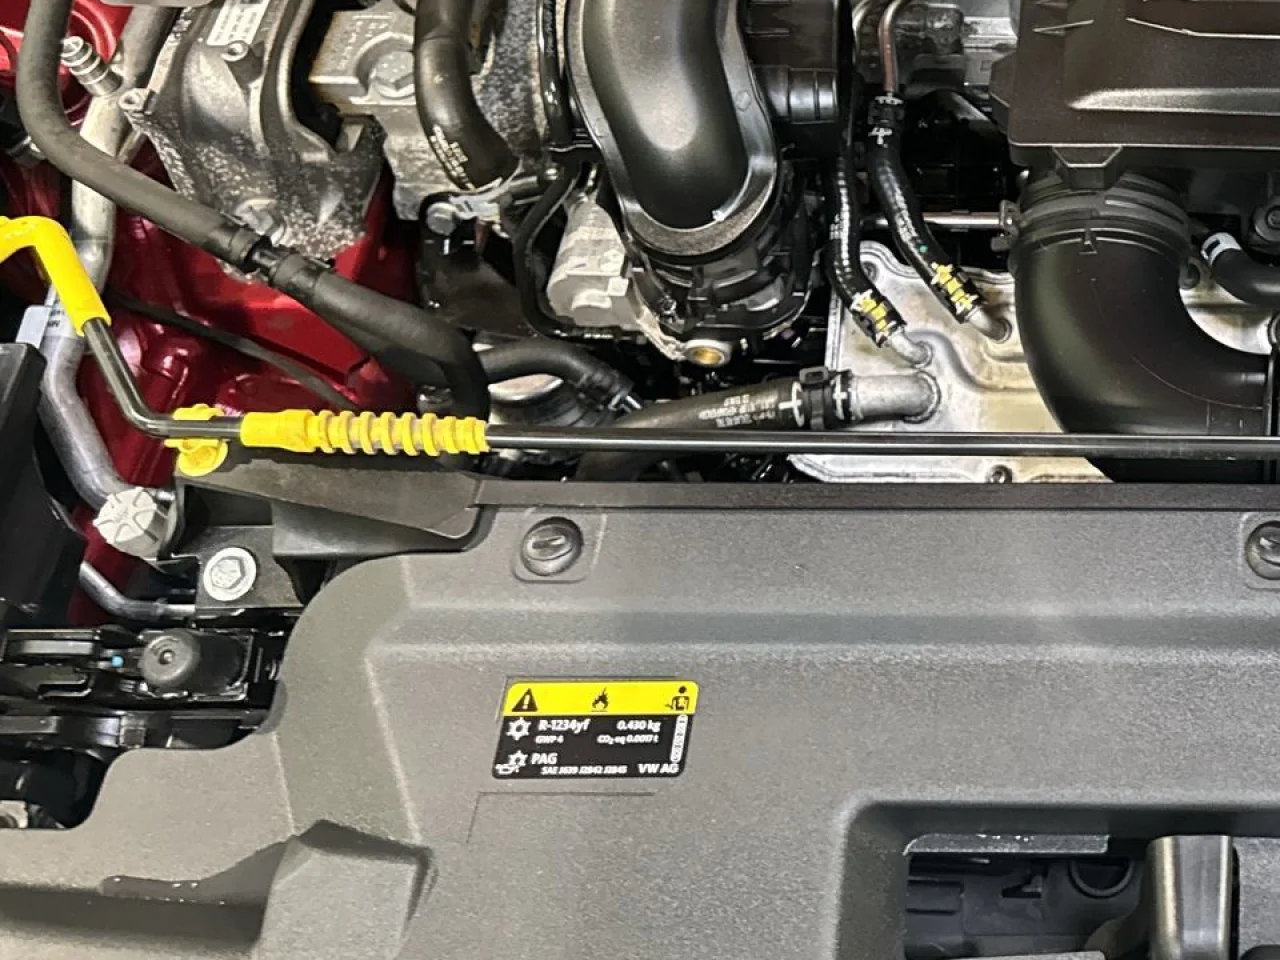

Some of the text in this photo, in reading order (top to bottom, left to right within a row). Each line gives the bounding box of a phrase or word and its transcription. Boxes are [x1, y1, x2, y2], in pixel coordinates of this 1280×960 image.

[538, 719, 591, 734] R-1234yf
[616, 720, 661, 732] 0.430 kg
[532, 752, 558, 764] PAG
[638, 762, 680, 774] VW AG
